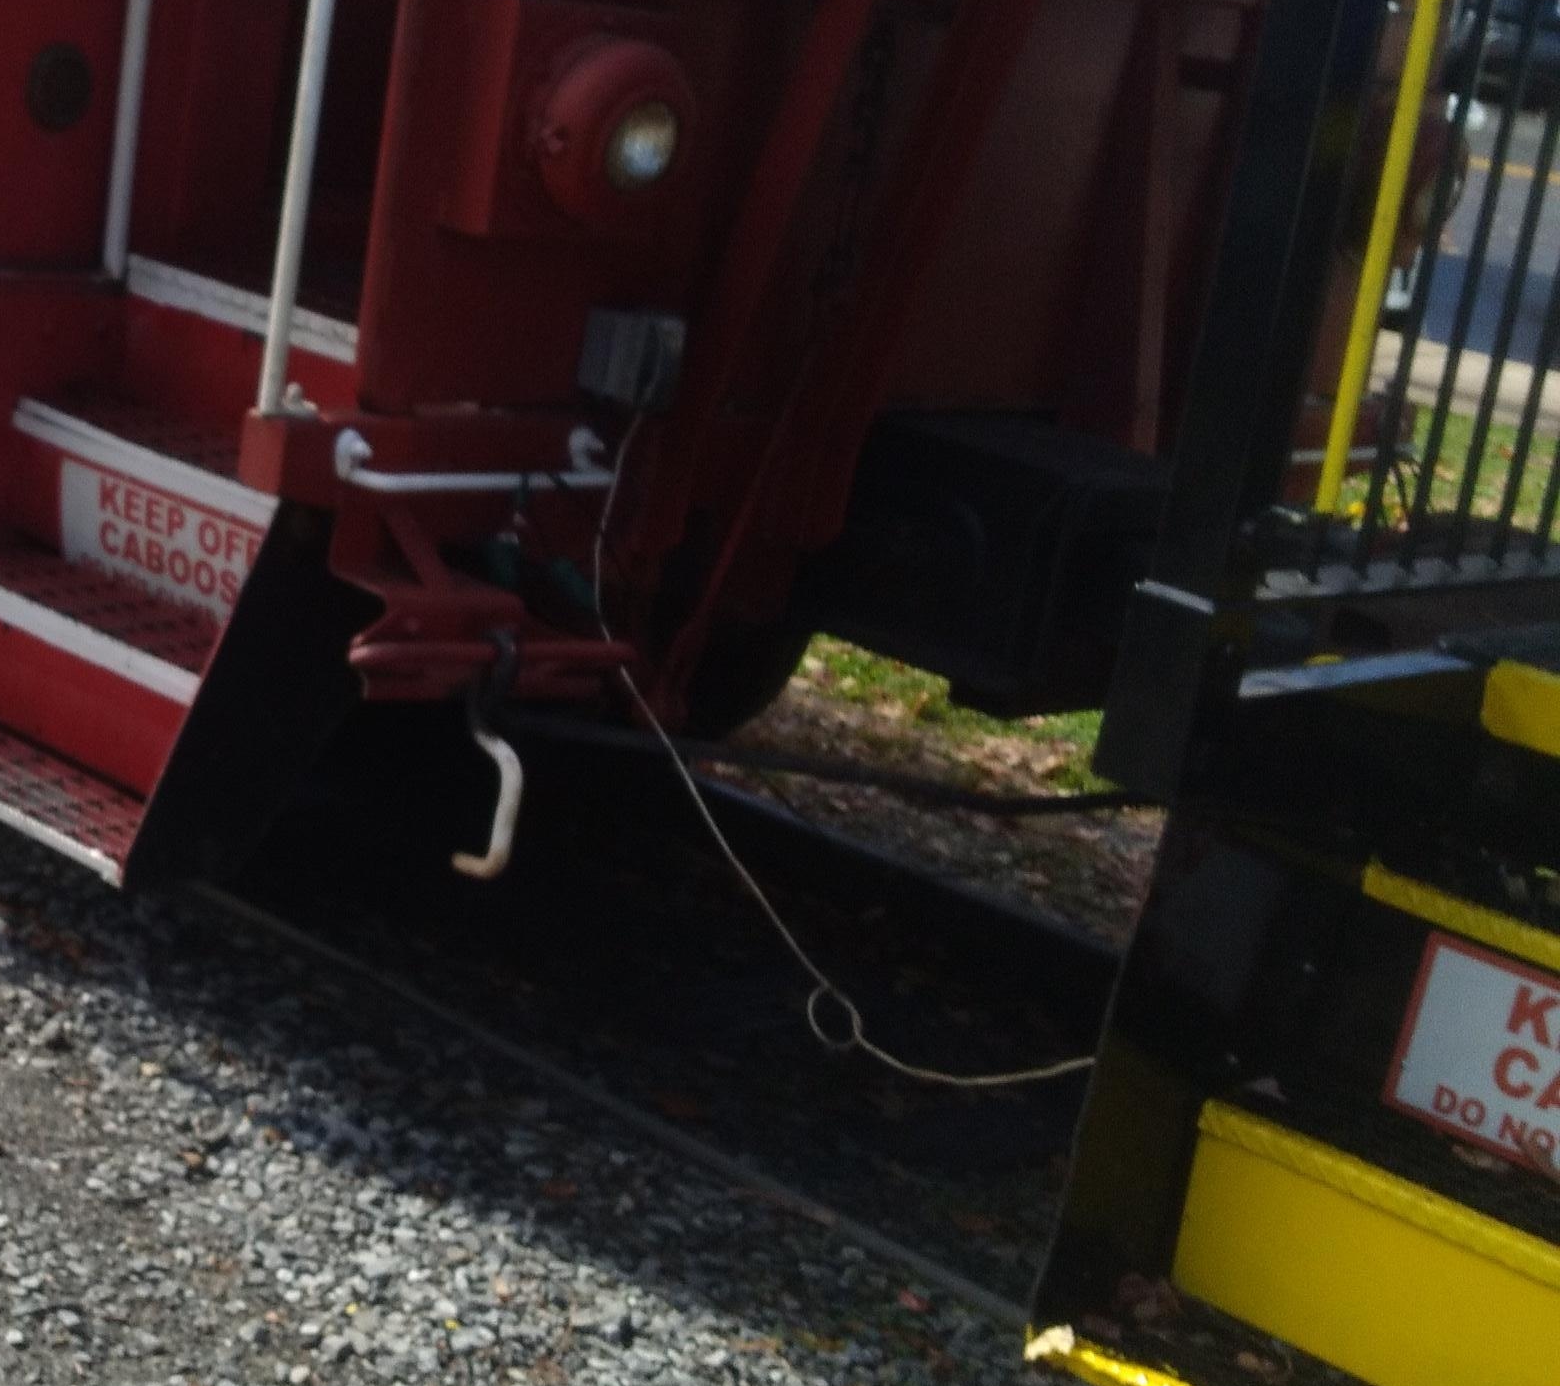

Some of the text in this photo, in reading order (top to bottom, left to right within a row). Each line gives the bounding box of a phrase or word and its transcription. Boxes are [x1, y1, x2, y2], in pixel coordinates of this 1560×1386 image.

[98, 477, 185, 537] KEEP
[1506, 984, 1560, 1051] K
[1433, 1083, 1487, 1127] DO
